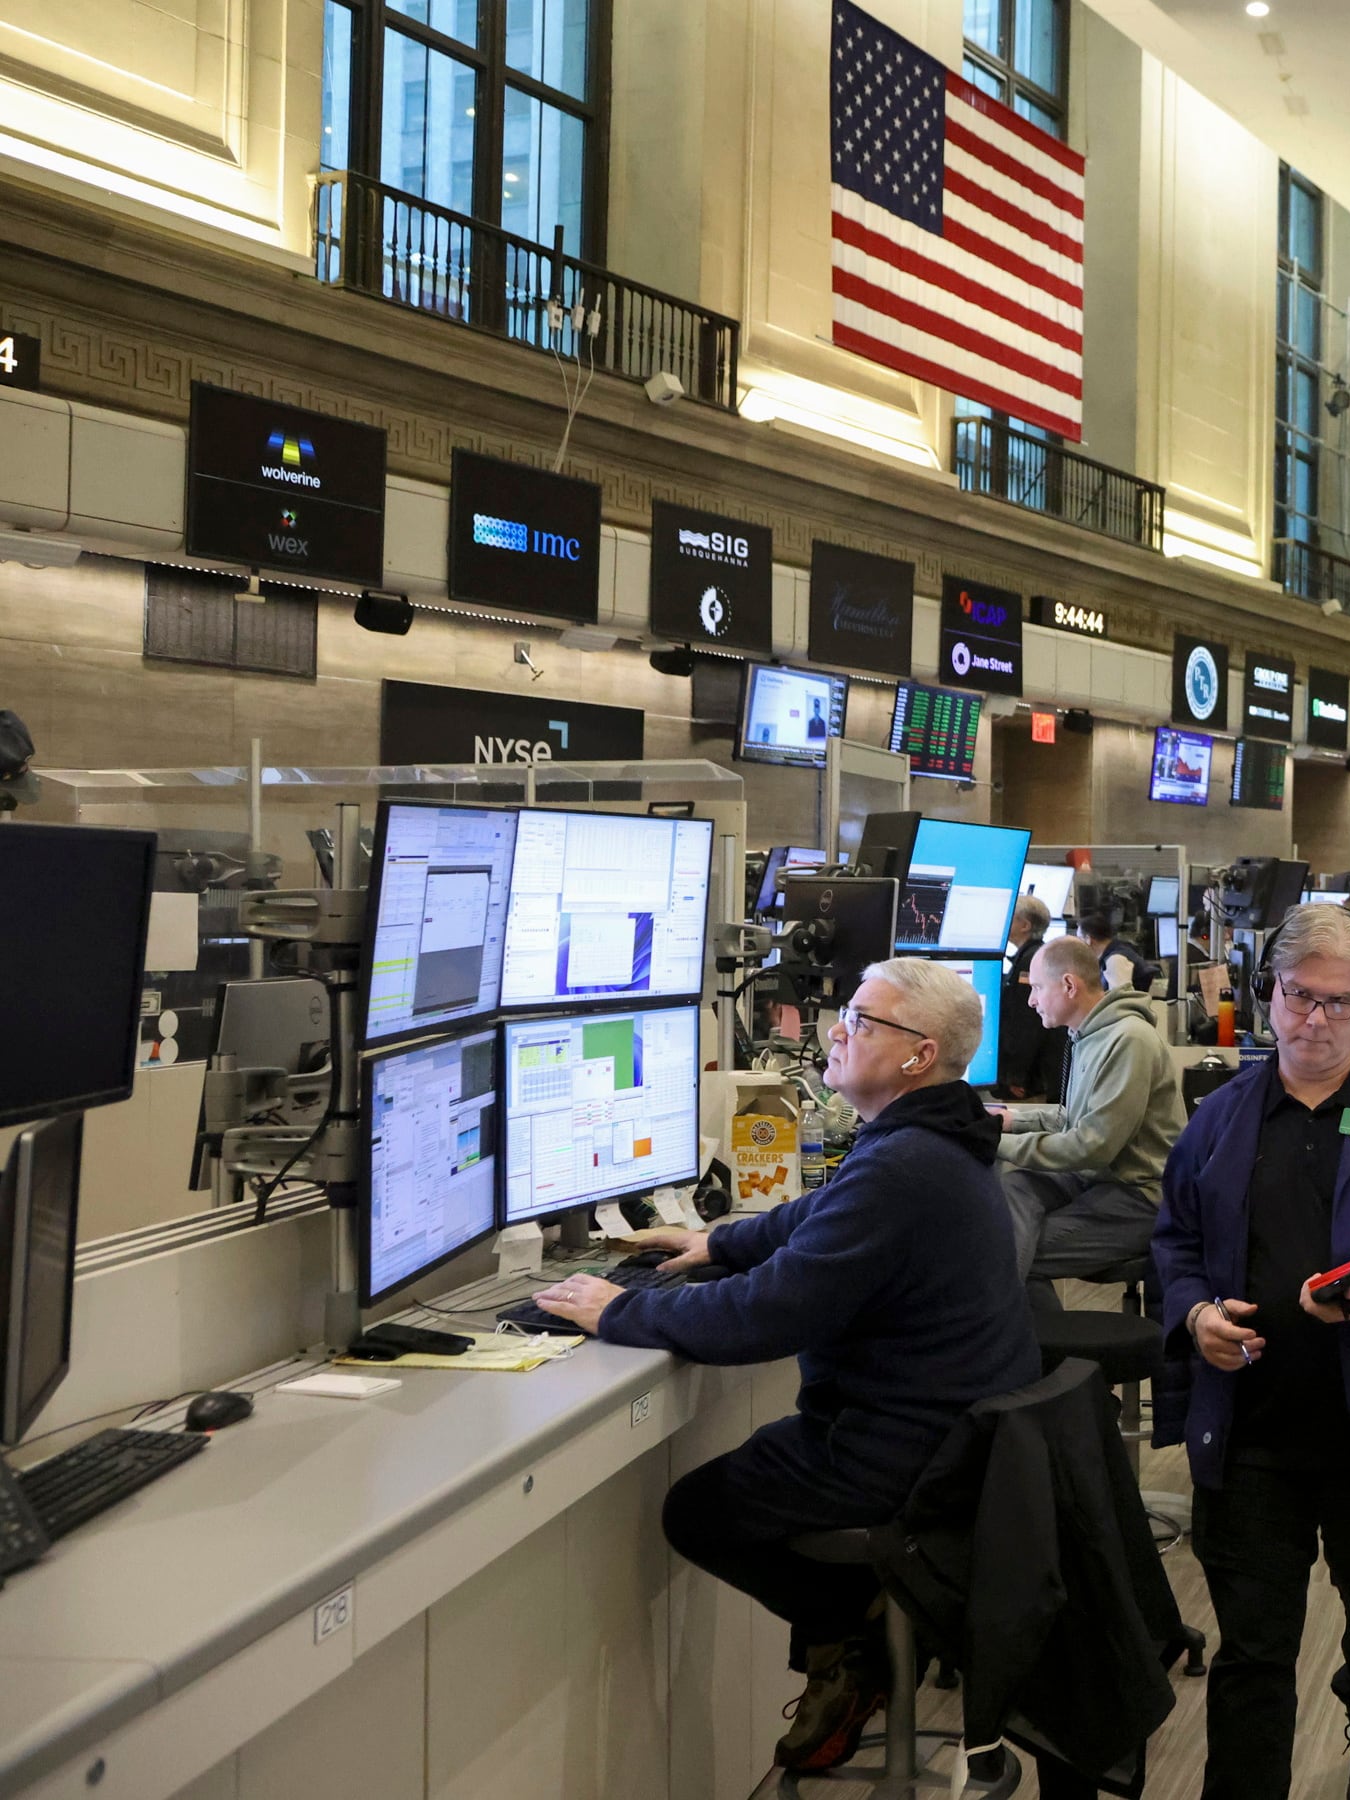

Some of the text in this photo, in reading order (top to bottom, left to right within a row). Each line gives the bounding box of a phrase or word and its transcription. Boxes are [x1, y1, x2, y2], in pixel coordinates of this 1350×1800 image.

[261, 465, 321, 488] wolverine
[268, 534, 308, 556] wex
[711, 531, 749, 558] SIG
[679, 545, 749, 568] SUSQUEHANNA
[972, 601, 1007, 627] ICAP
[1055, 602, 1104, 634] 9:44:44
[971, 654, 1014, 674] Jane Street
[736, 1153, 784, 1163] CRACKERS
[321, 1595, 347, 1636] 218
